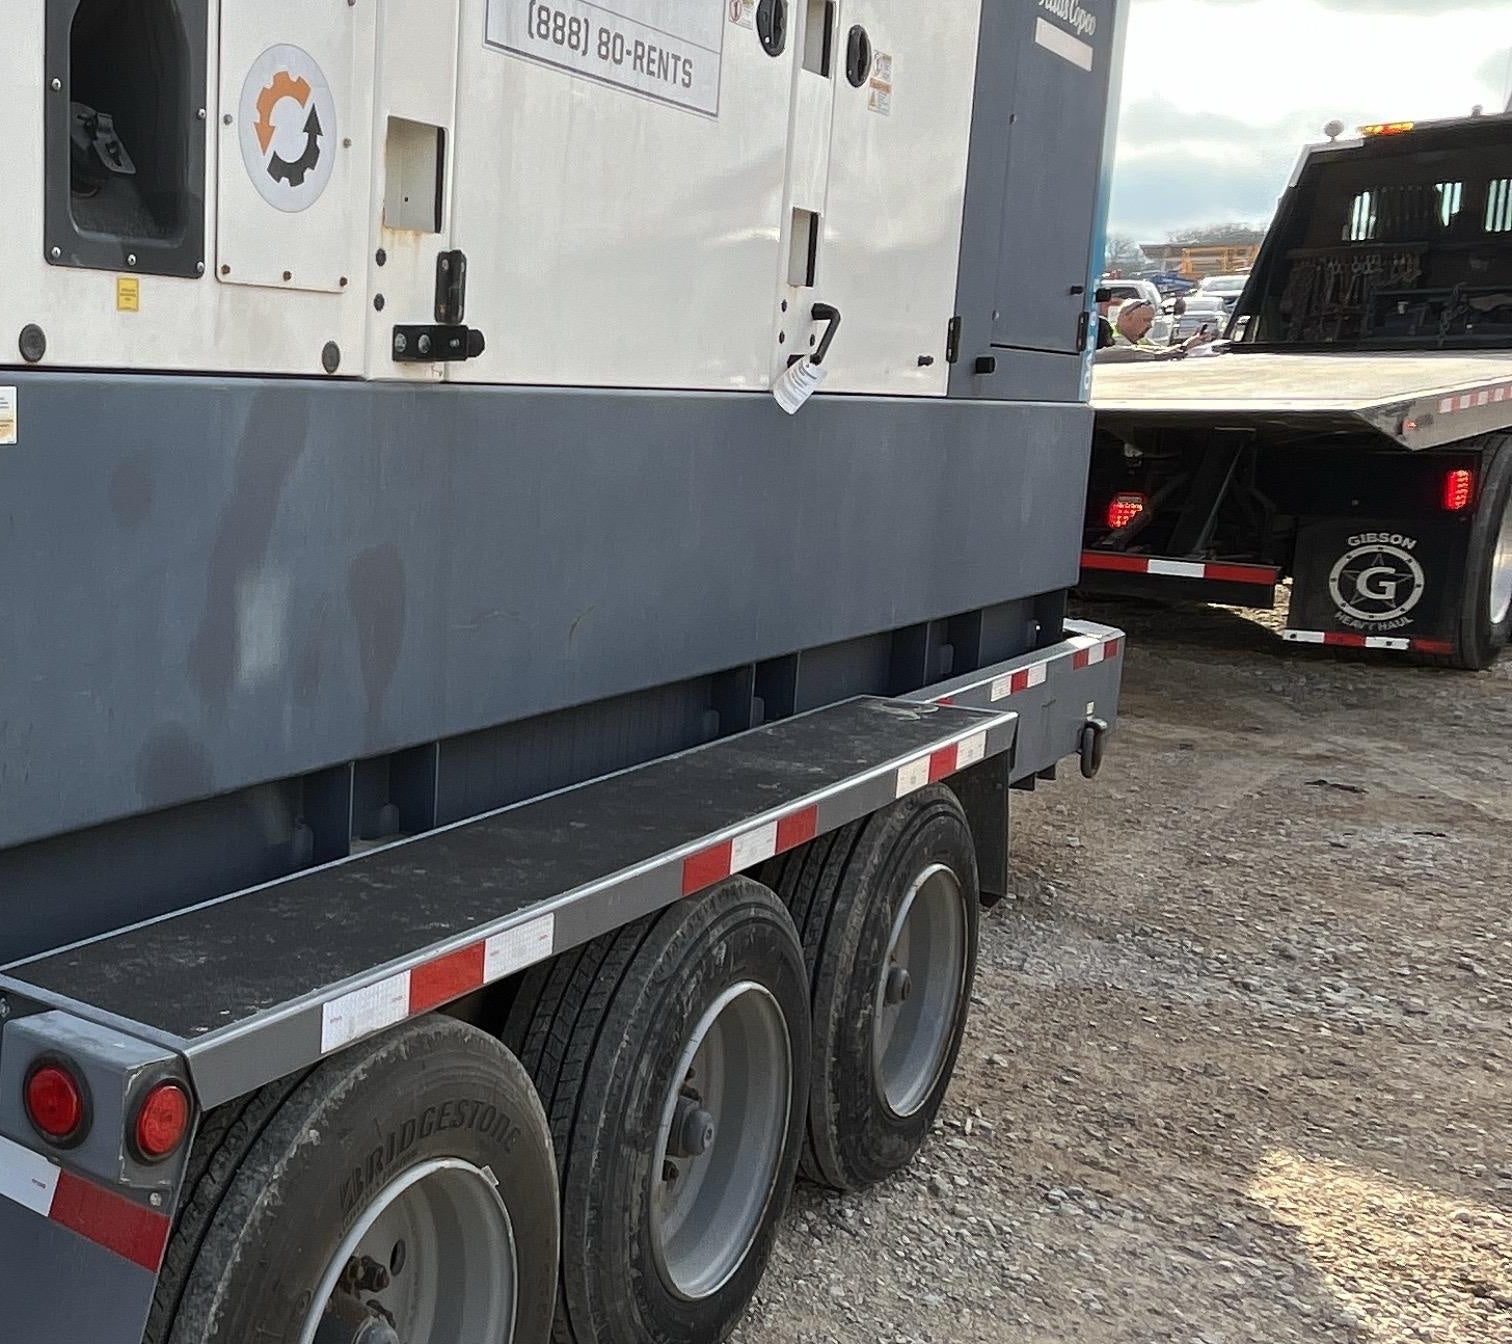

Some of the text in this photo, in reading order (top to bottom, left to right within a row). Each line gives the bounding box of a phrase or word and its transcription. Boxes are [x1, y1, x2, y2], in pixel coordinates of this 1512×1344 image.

[528, 0, 693, 88] (888) 80-RENTS
[1347, 532, 1417, 549] GIBSON
[1356, 566, 1397, 599] G
[1335, 611, 1414, 631] HEAVY HAUL
